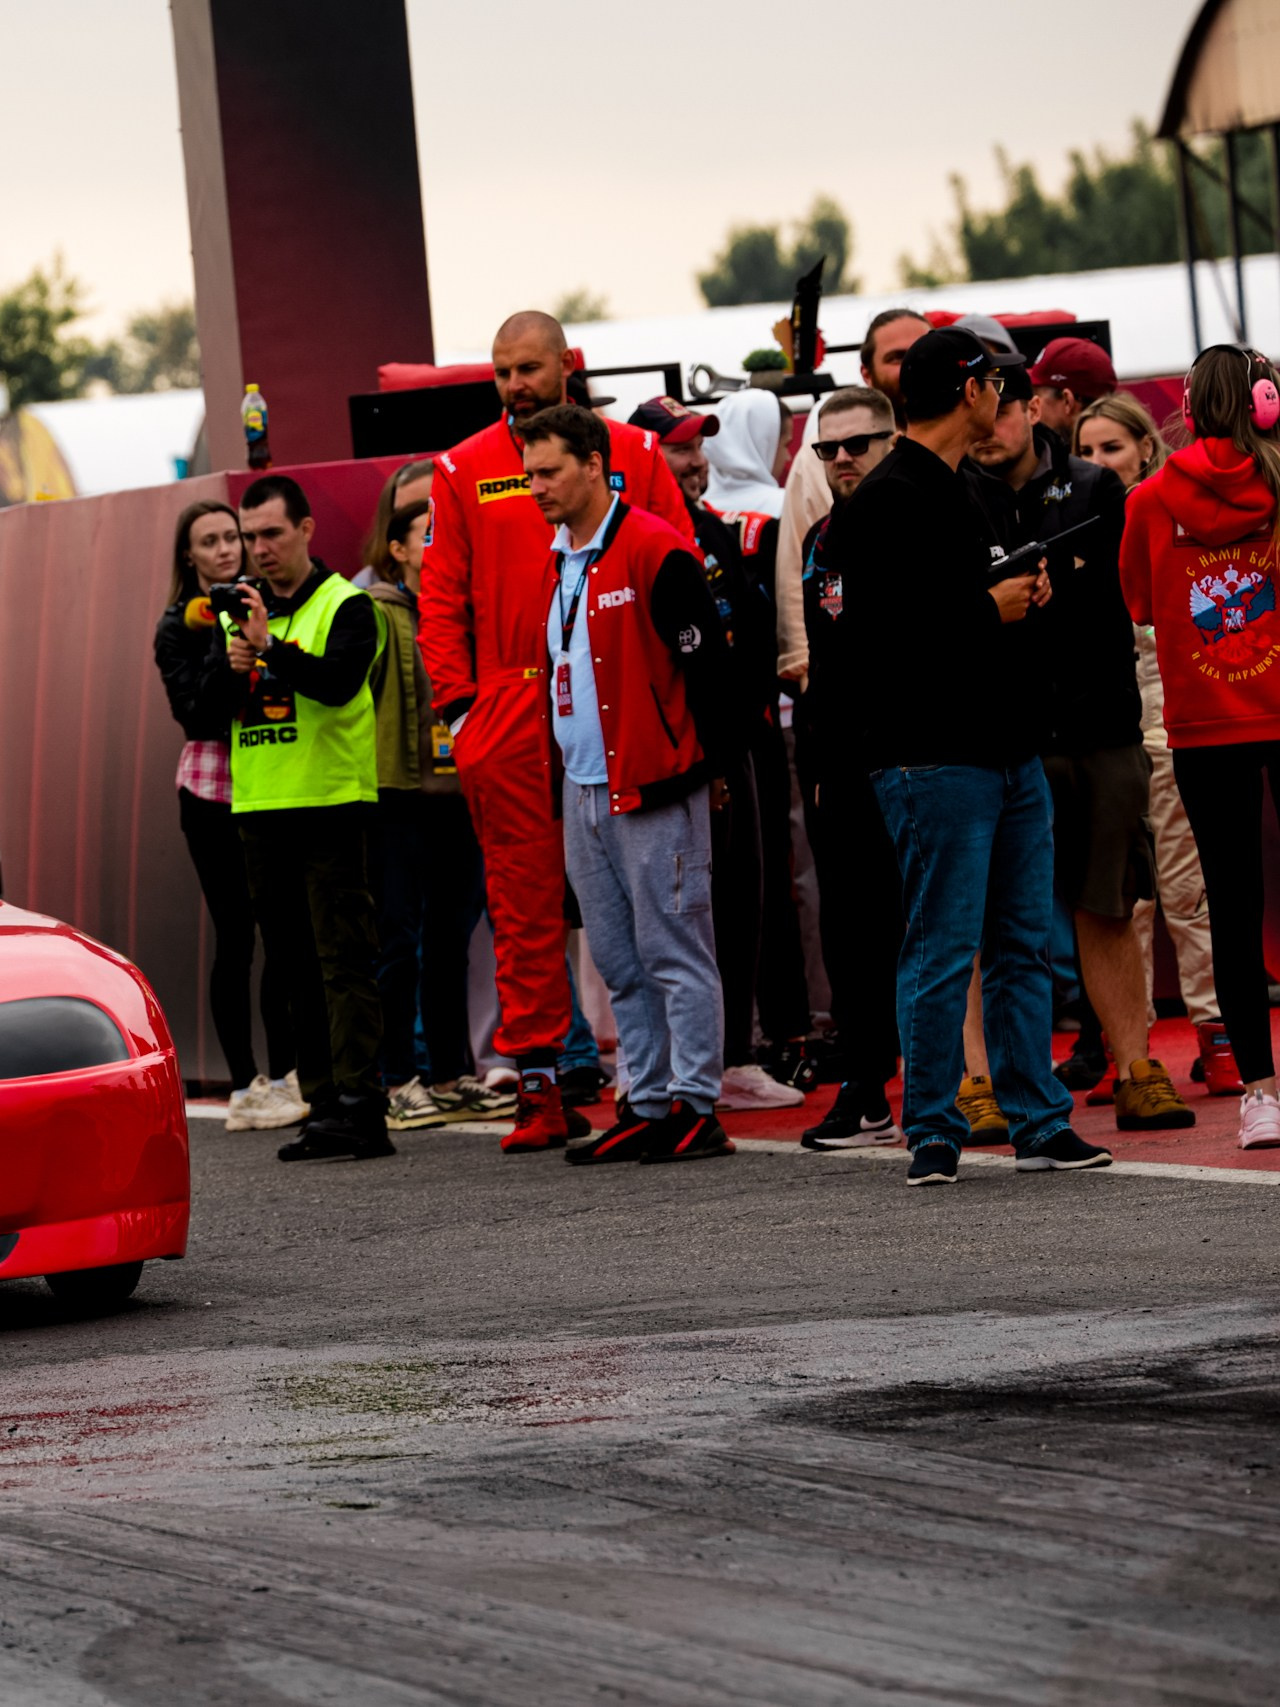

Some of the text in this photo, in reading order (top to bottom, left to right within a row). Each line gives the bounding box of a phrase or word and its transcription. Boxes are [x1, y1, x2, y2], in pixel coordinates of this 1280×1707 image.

[479, 478, 531, 497] RDRC
[1186, 548, 1276, 577] С НАМИ БОГ
[1198, 661, 1221, 681] ДВА
[1228, 644, 1280, 683] ПАРАШЮТА
[239, 726, 298, 749] RDRC
